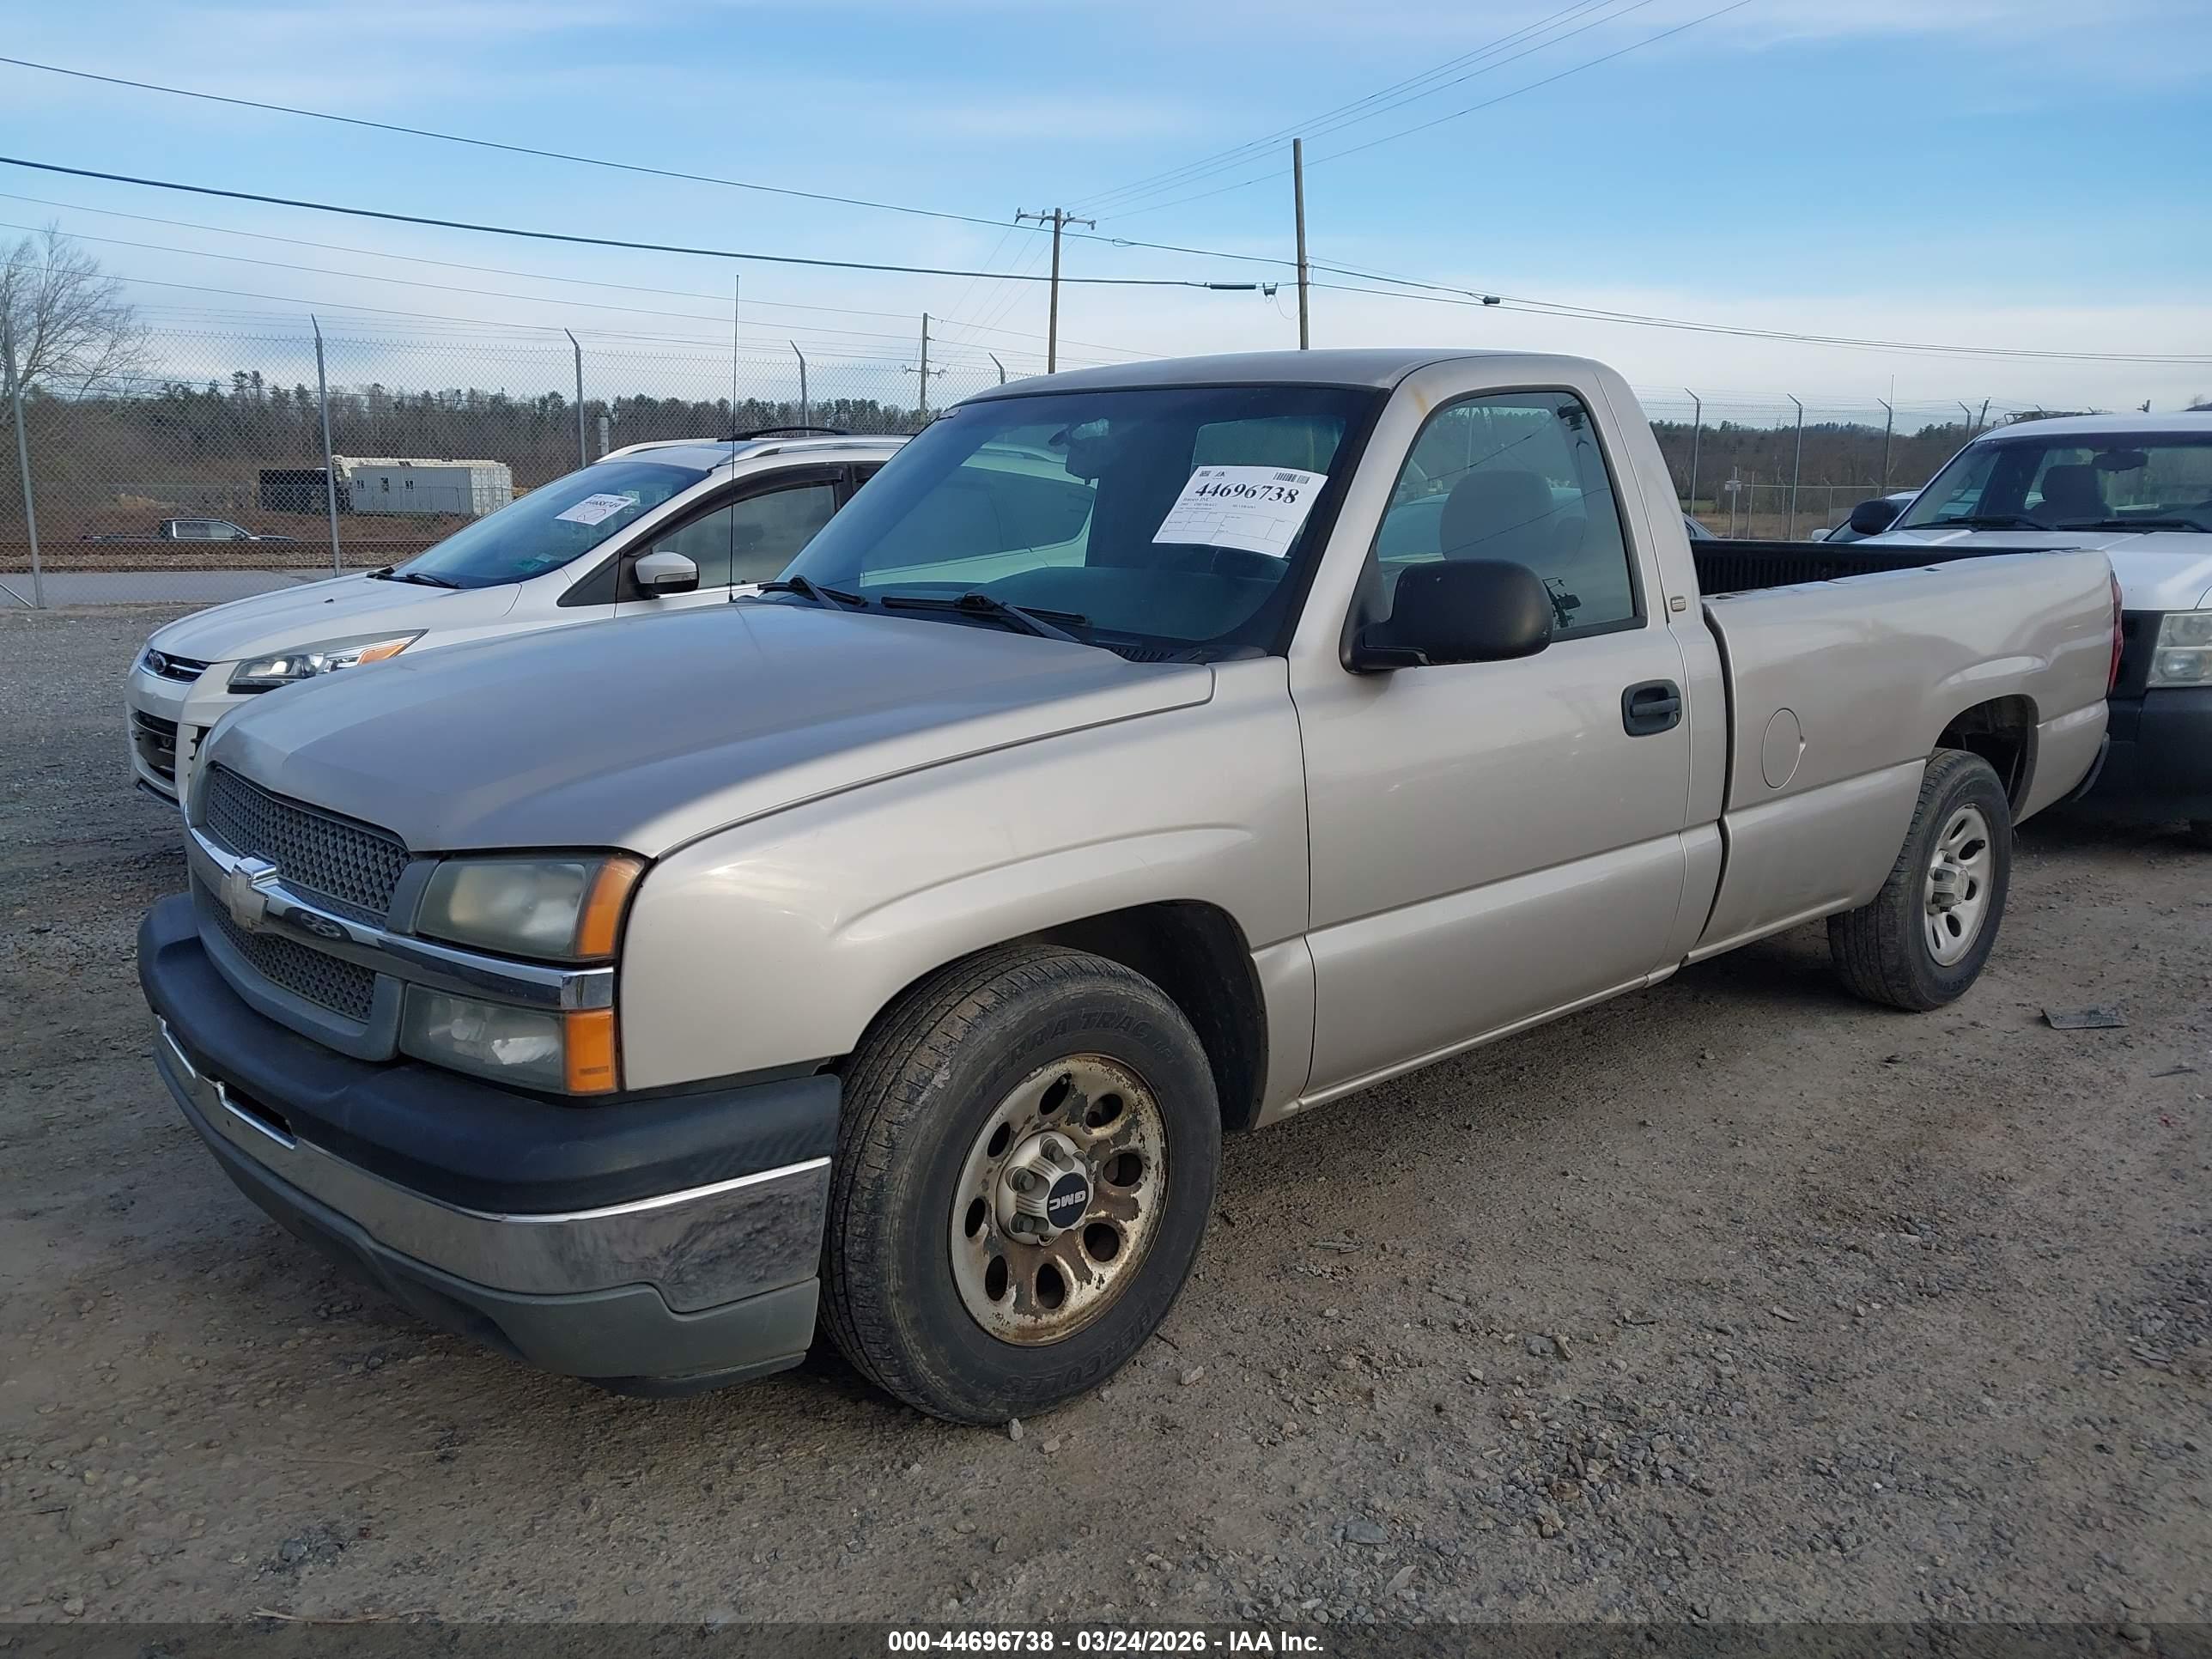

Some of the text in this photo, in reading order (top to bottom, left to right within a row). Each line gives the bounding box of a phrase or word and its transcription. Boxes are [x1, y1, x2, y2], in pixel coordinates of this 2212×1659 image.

[1194, 482, 1299, 504] 44696738
[1078, 1008, 1154, 1039] TRAC
[1048, 1190, 1086, 1211] GMC
[1002, 1302, 1155, 1401] HERCULES
